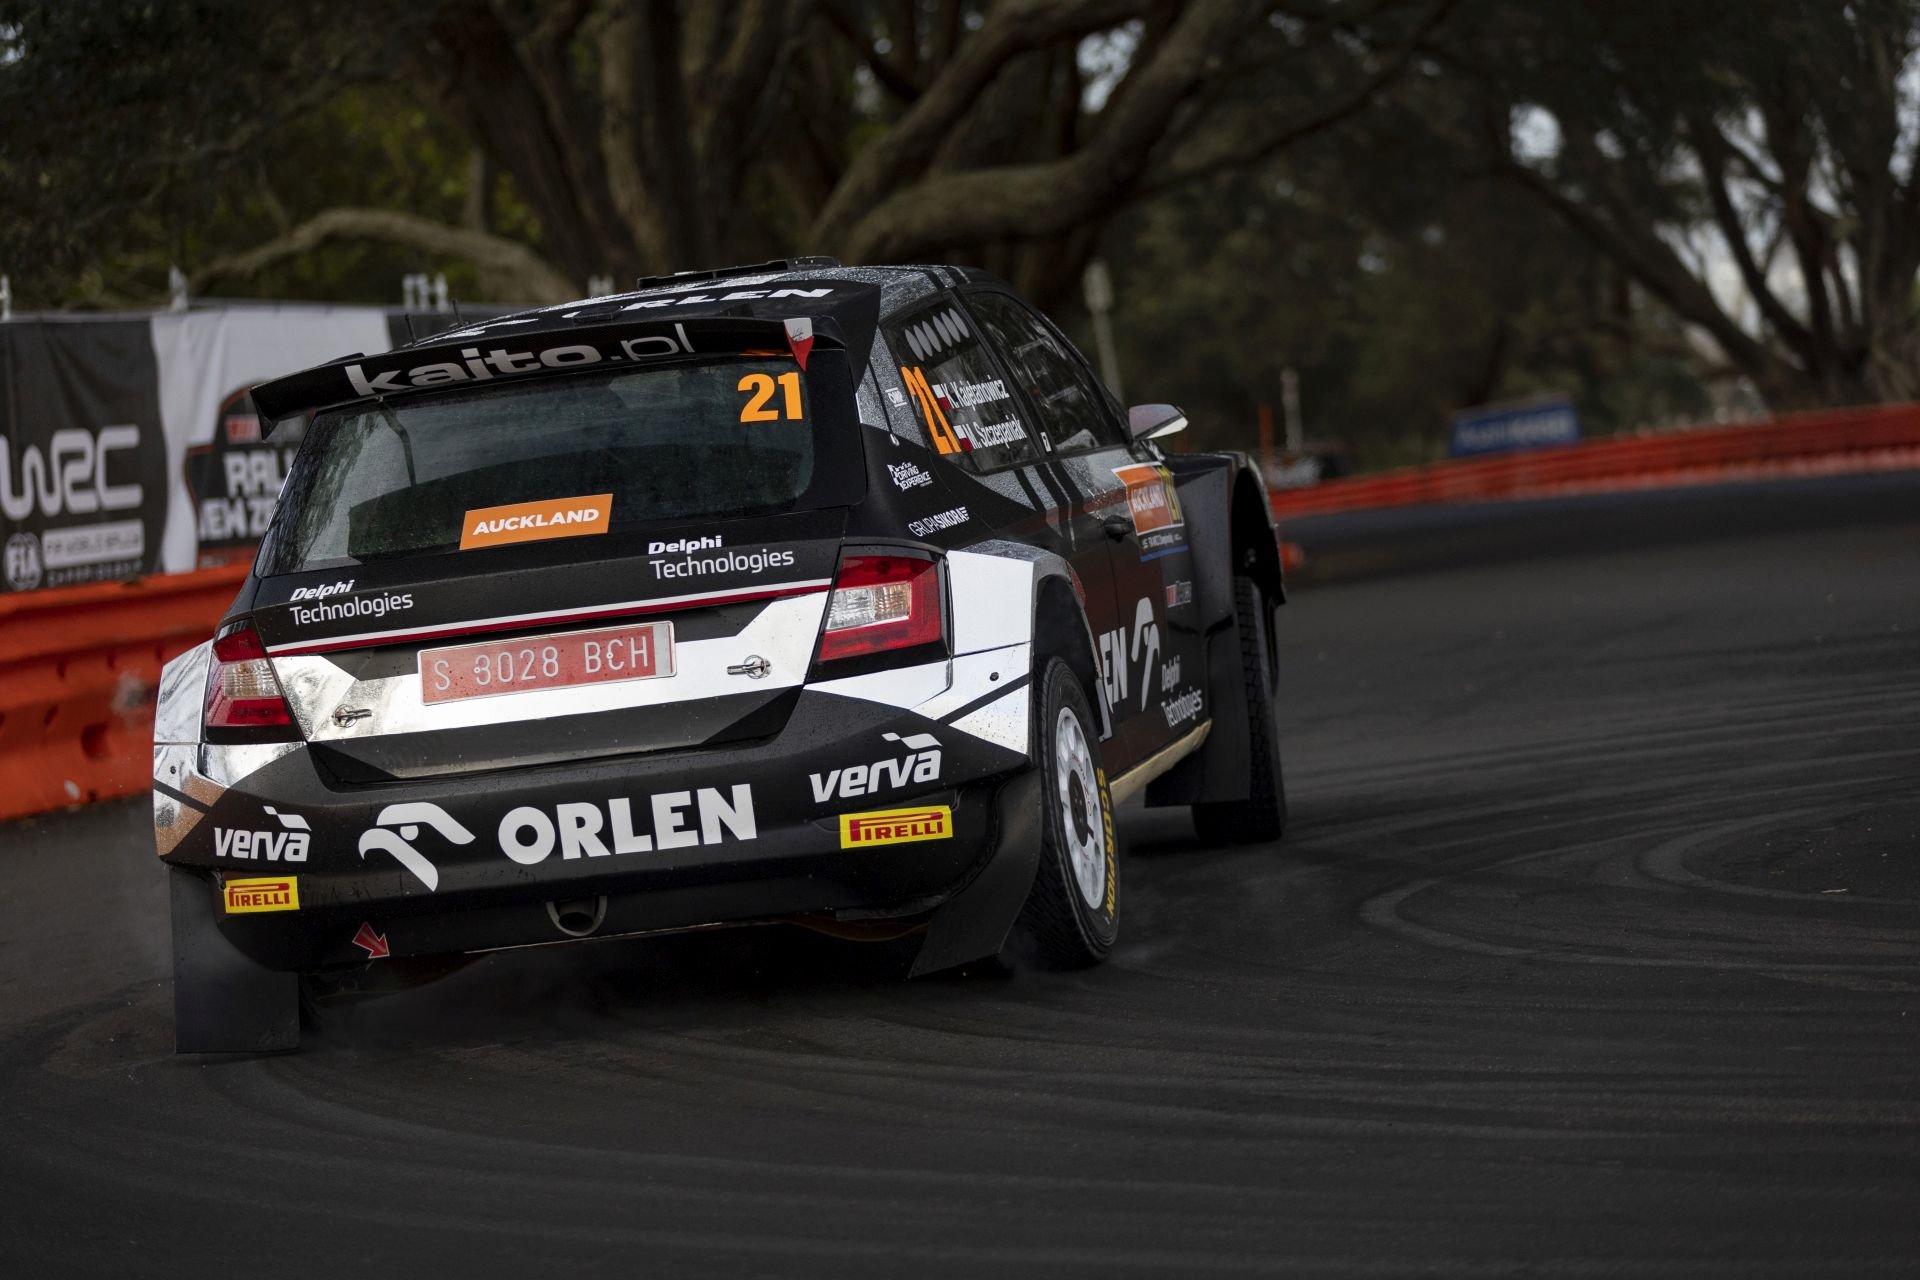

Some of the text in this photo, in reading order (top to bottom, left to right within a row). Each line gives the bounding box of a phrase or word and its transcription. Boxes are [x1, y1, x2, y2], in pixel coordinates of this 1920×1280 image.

[562, 288, 834, 318] RLEN
[737, 371, 804, 424] 21
[901, 366, 962, 455] 21
[941, 374, 1010, 411] K. Kajetanowicz
[962, 423, 983, 450] M.
[973, 413, 1028, 449] Szczepaniak
[0, 424, 143, 520] WRC
[899, 465, 920, 481] DRIVING
[901, 471, 932, 490] EXPERIENCE
[472, 508, 600, 536] AUCKLAND
[648, 535, 722, 555] Delphi
[649, 549, 795, 580] Technologies
[289, 579, 355, 602] Delphi
[289, 592, 414, 625] Technologies
[434, 635, 650, 691] S 3028 BCH
[1161, 654, 1181, 693] Delphi
[1161, 685, 1203, 728] Technologies
[809, 746, 943, 804] verva
[497, 783, 758, 865] ORLEN
[849, 811, 945, 842] PIRELLI
[213, 826, 312, 862] verva
[1096, 766, 1117, 921] SCORPION
[228, 882, 291, 907] PIRELLI
